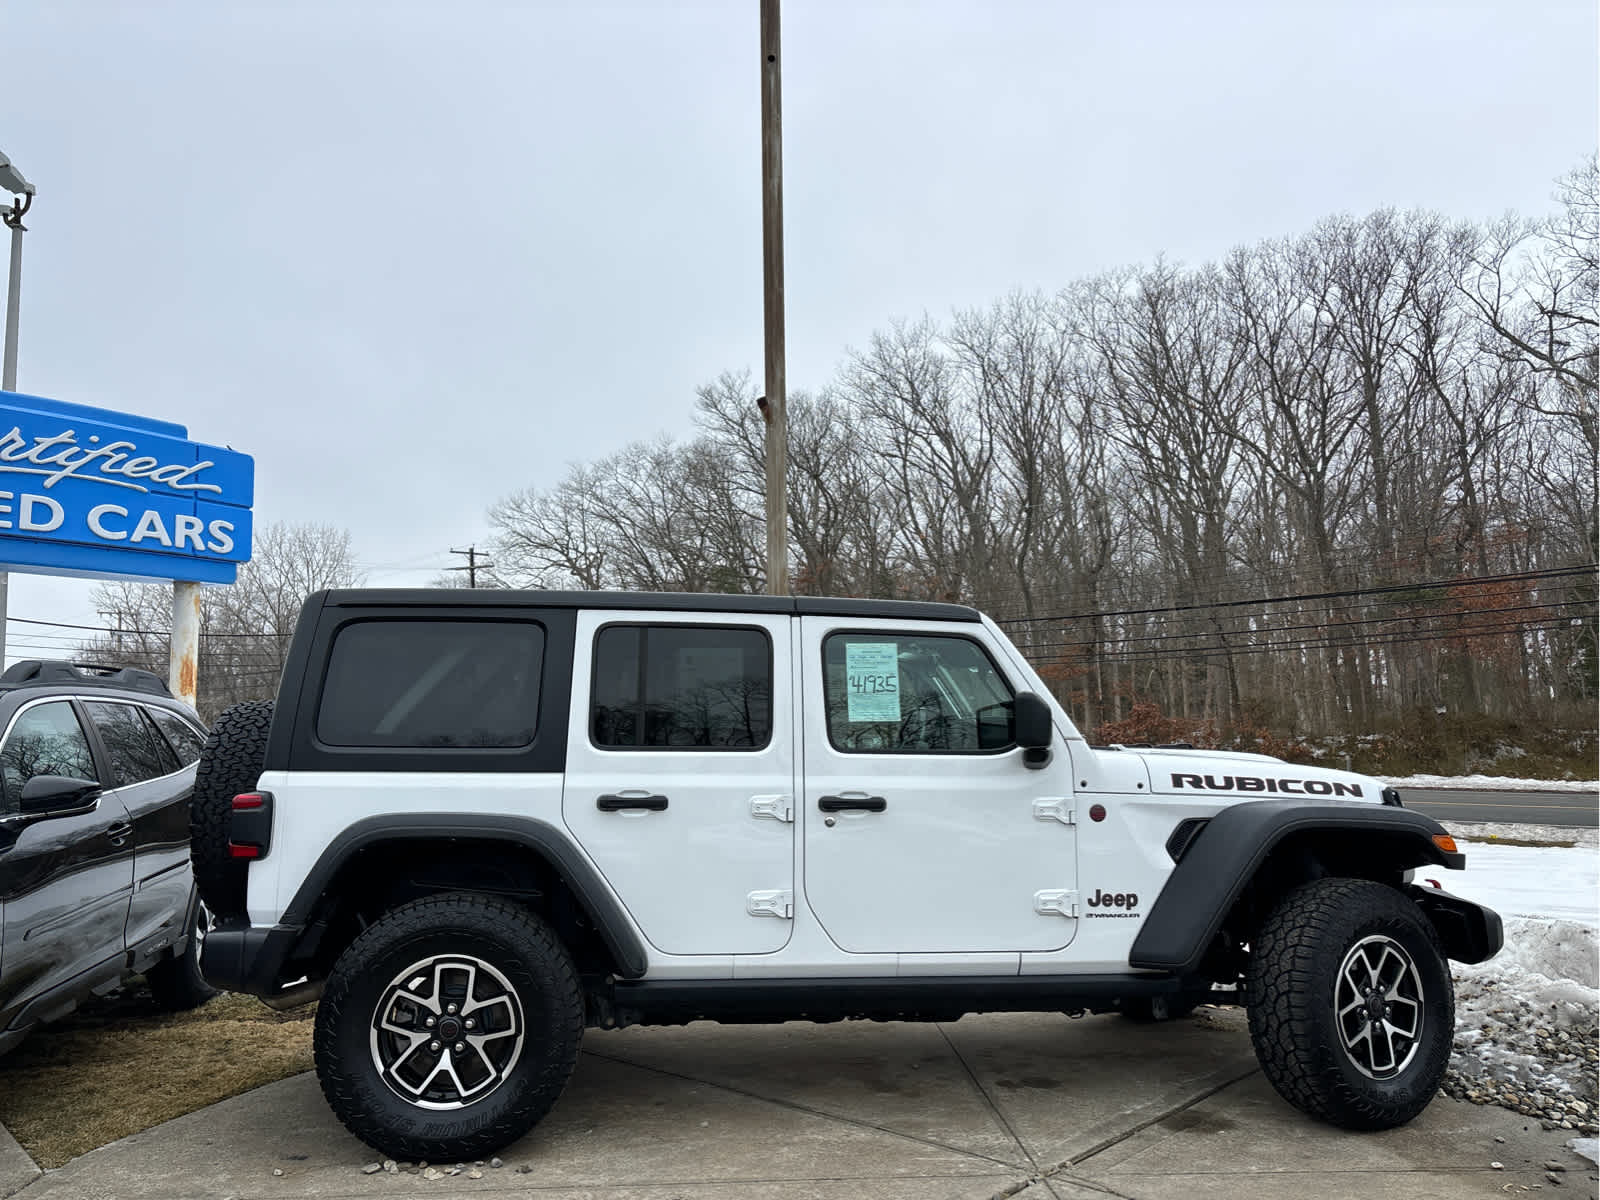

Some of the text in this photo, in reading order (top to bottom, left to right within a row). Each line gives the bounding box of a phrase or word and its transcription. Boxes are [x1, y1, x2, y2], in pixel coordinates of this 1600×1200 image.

[87, 504, 235, 554] CARS
[849, 674, 897, 694] 41935
[1171, 773, 1363, 797] RUBICON
[1087, 888, 1138, 910] Jeep
